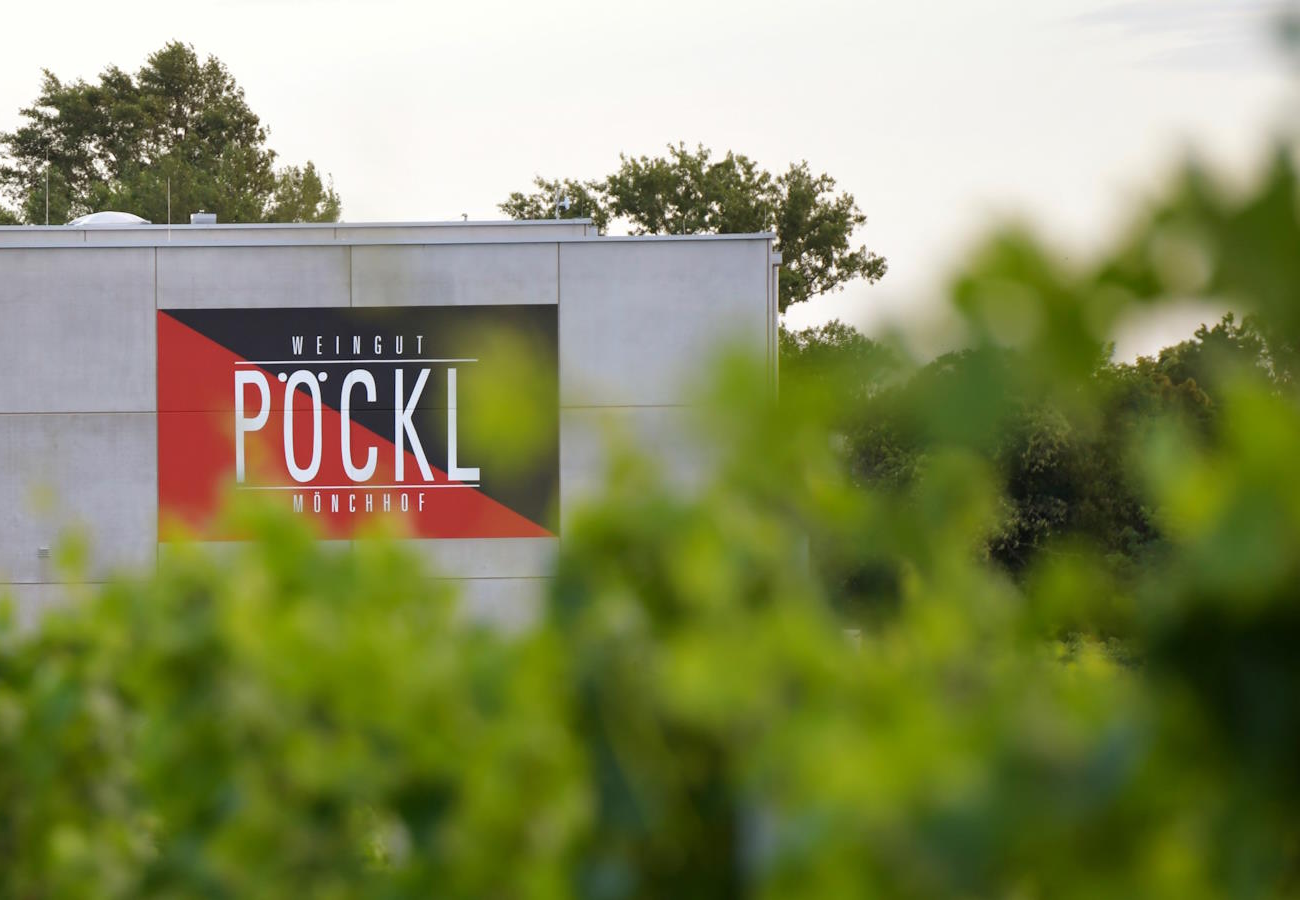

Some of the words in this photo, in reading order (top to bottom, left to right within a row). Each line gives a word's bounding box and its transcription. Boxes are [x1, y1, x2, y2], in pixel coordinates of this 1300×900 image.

[292, 335, 425, 355] WEINGUT
[234, 367, 480, 483] PÖCKL
[293, 491, 426, 513] MÖNCHHOF
